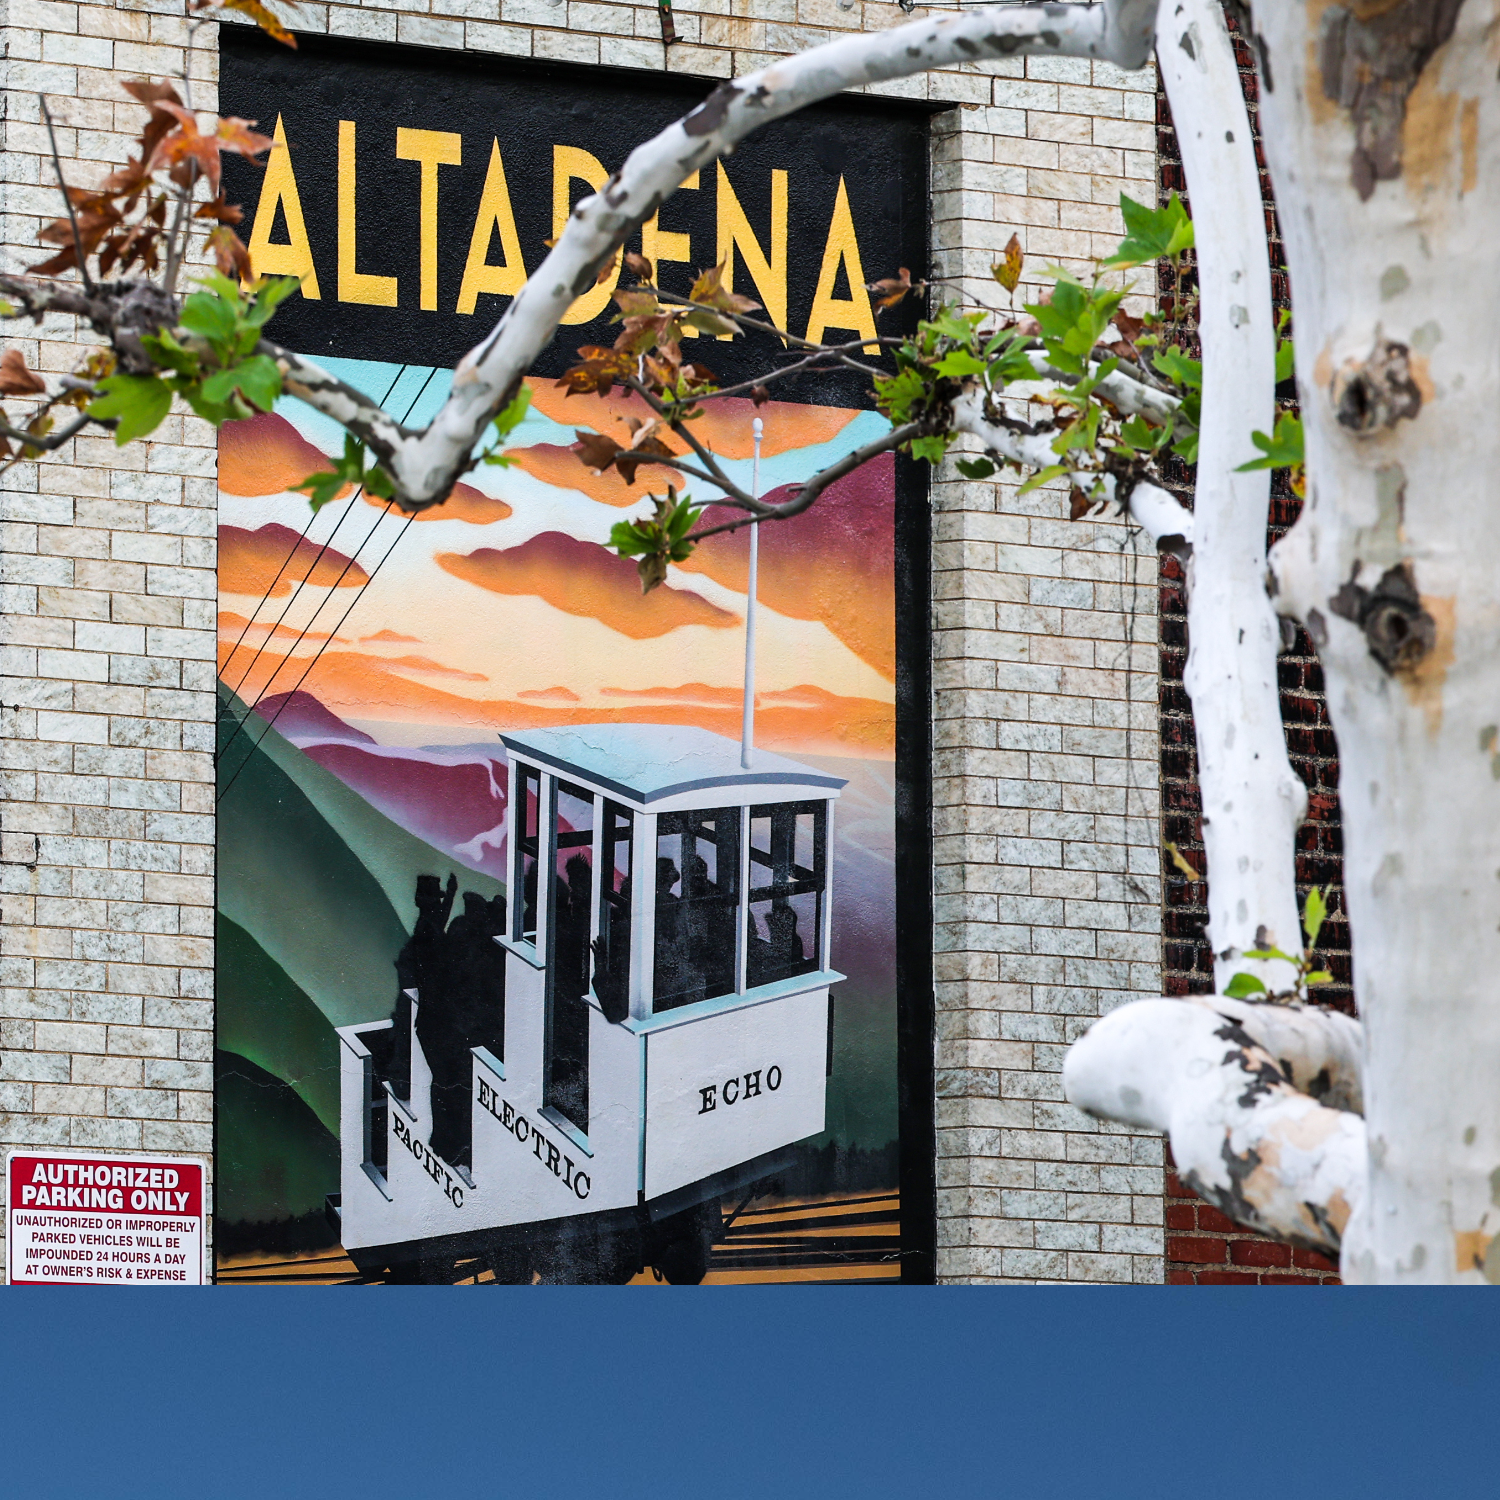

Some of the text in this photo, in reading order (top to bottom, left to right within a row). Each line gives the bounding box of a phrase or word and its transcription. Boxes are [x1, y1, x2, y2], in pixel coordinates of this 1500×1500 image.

[239, 112, 881, 356] ALTADENA
[697, 1065, 783, 1115] ECHO
[476, 1076, 592, 1199] ELECTRIC
[391, 1111, 464, 1209] PACIFIC
[31, 1163, 179, 1189] AUTHORIZED
[22, 1185, 190, 1212] PARKING ONLY
[16, 1214, 196, 1233] UNAUTHORIZED OR IMPROPERLY
[31, 1232, 180, 1248] PARKED VEHICLES WILL BE
[25, 1248, 186, 1265] IMPOUNDED 24 HOURS A DAY
[25, 1264, 186, 1281] AT OWNER'S RISK & EXPENSE
